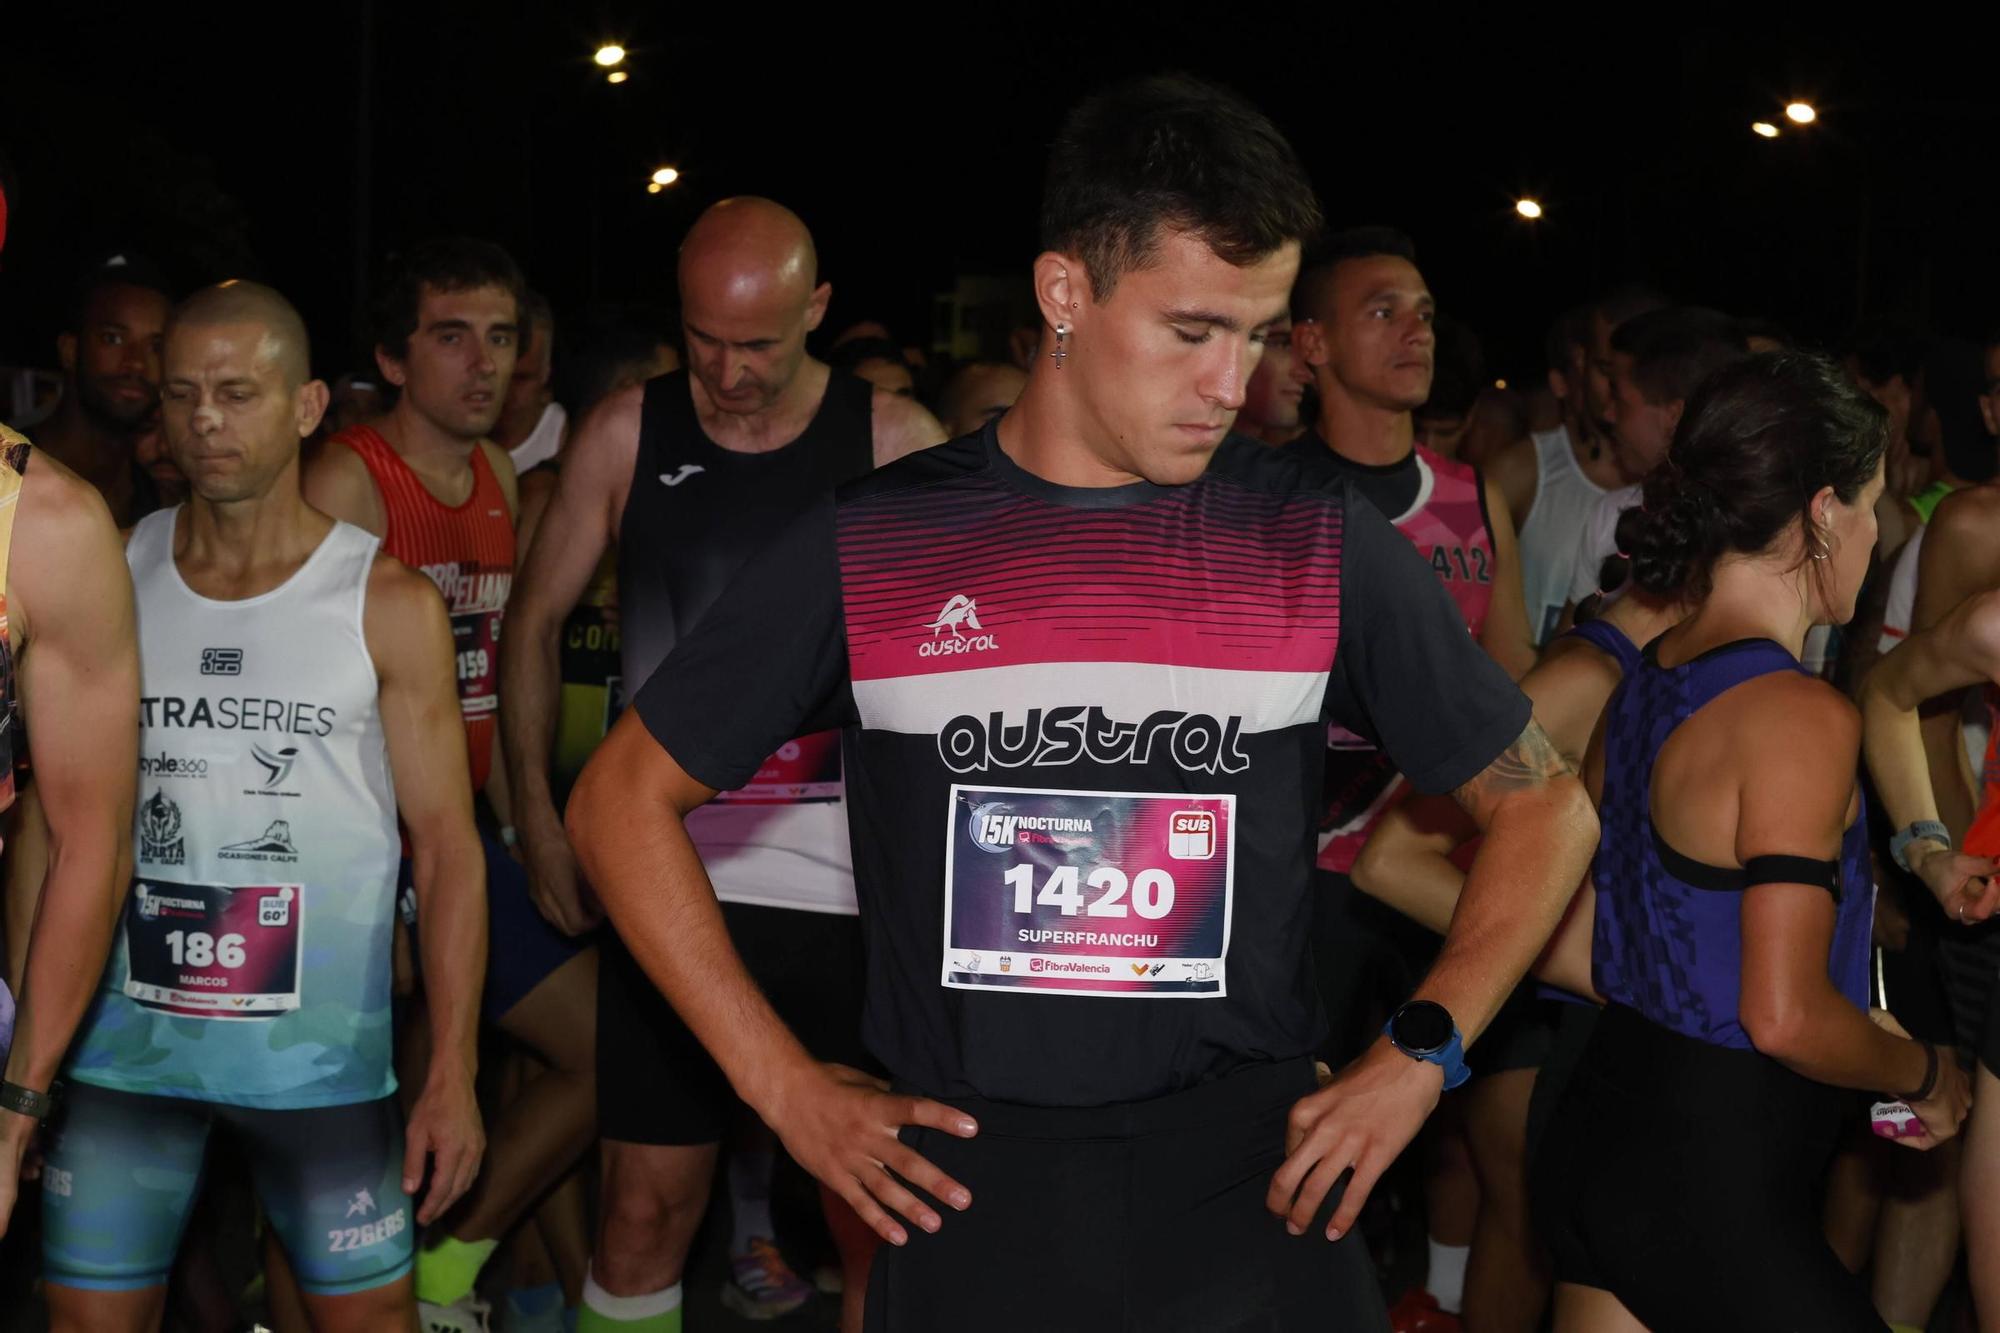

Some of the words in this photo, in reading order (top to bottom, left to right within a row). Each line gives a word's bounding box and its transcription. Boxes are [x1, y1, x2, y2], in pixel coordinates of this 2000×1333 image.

[918, 633, 999, 657] austral
[139, 697, 337, 737] TRASERIES
[936, 706, 1250, 775] austral
[978, 814, 1018, 845] 15K
[1018, 816, 1092, 833] NOCTURNA
[1175, 818, 1210, 833] SUB
[217, 852, 268, 861] OCASIONES
[270, 854, 298, 863] CALPE
[1004, 863, 1176, 920] 1420
[165, 929, 247, 969] 186
[1018, 929, 1158, 948] SUPERFRANCHU
[1044, 960, 1111, 974] FibraValencia
[179, 975, 229, 987] MARCOS
[328, 1208, 406, 1253] 226ERS
